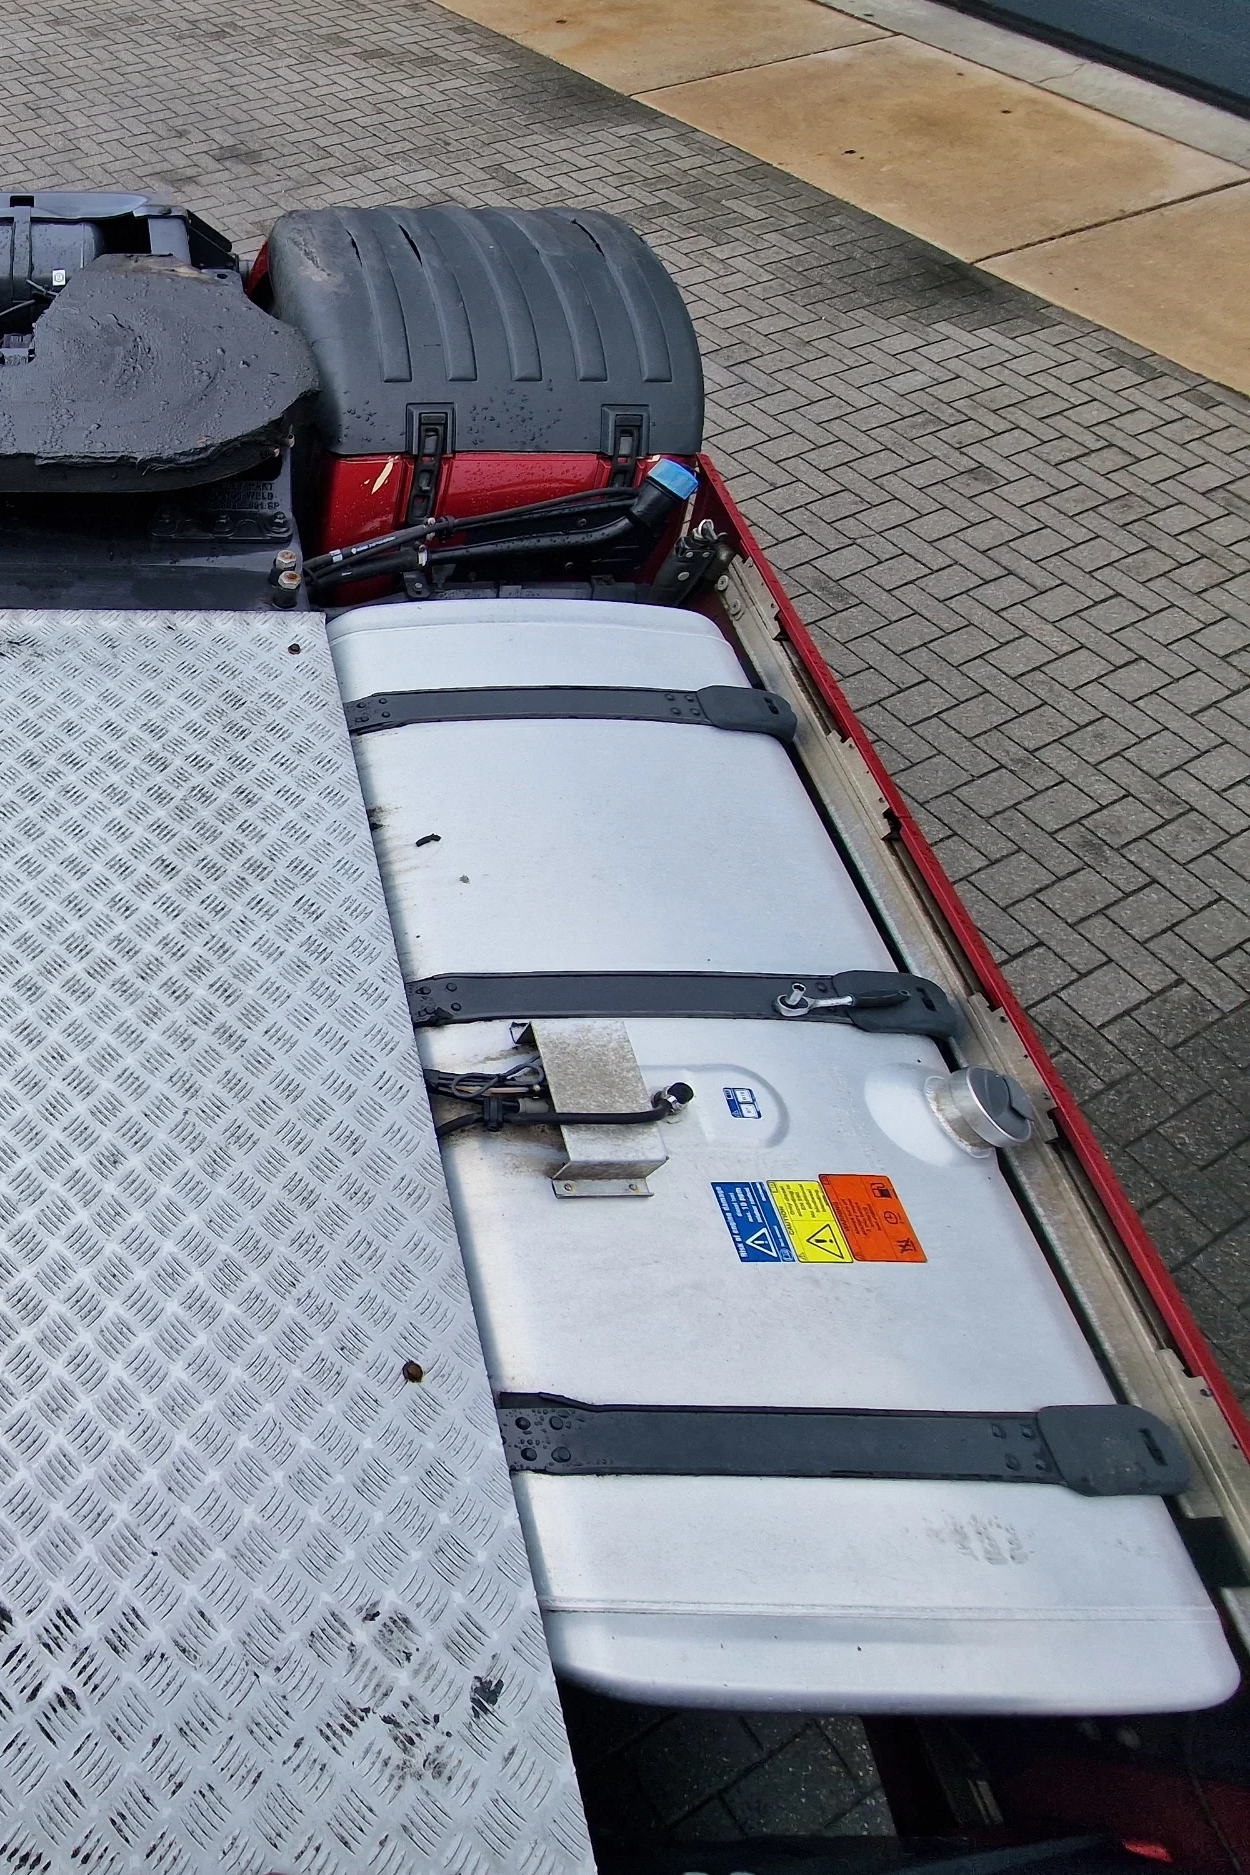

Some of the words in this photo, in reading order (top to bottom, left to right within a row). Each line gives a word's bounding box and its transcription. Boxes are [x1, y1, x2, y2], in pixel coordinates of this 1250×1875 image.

[247, 491, 274, 500] WELD
[715, 1186, 731, 1210] damage
[735, 1187, 746, 1201] ppm
[725, 1212, 740, 1233] engine
[779, 1206, 795, 1235] CAUTION
[833, 1201, 850, 1232] WARNING
[736, 1243, 749, 1257] Risk
